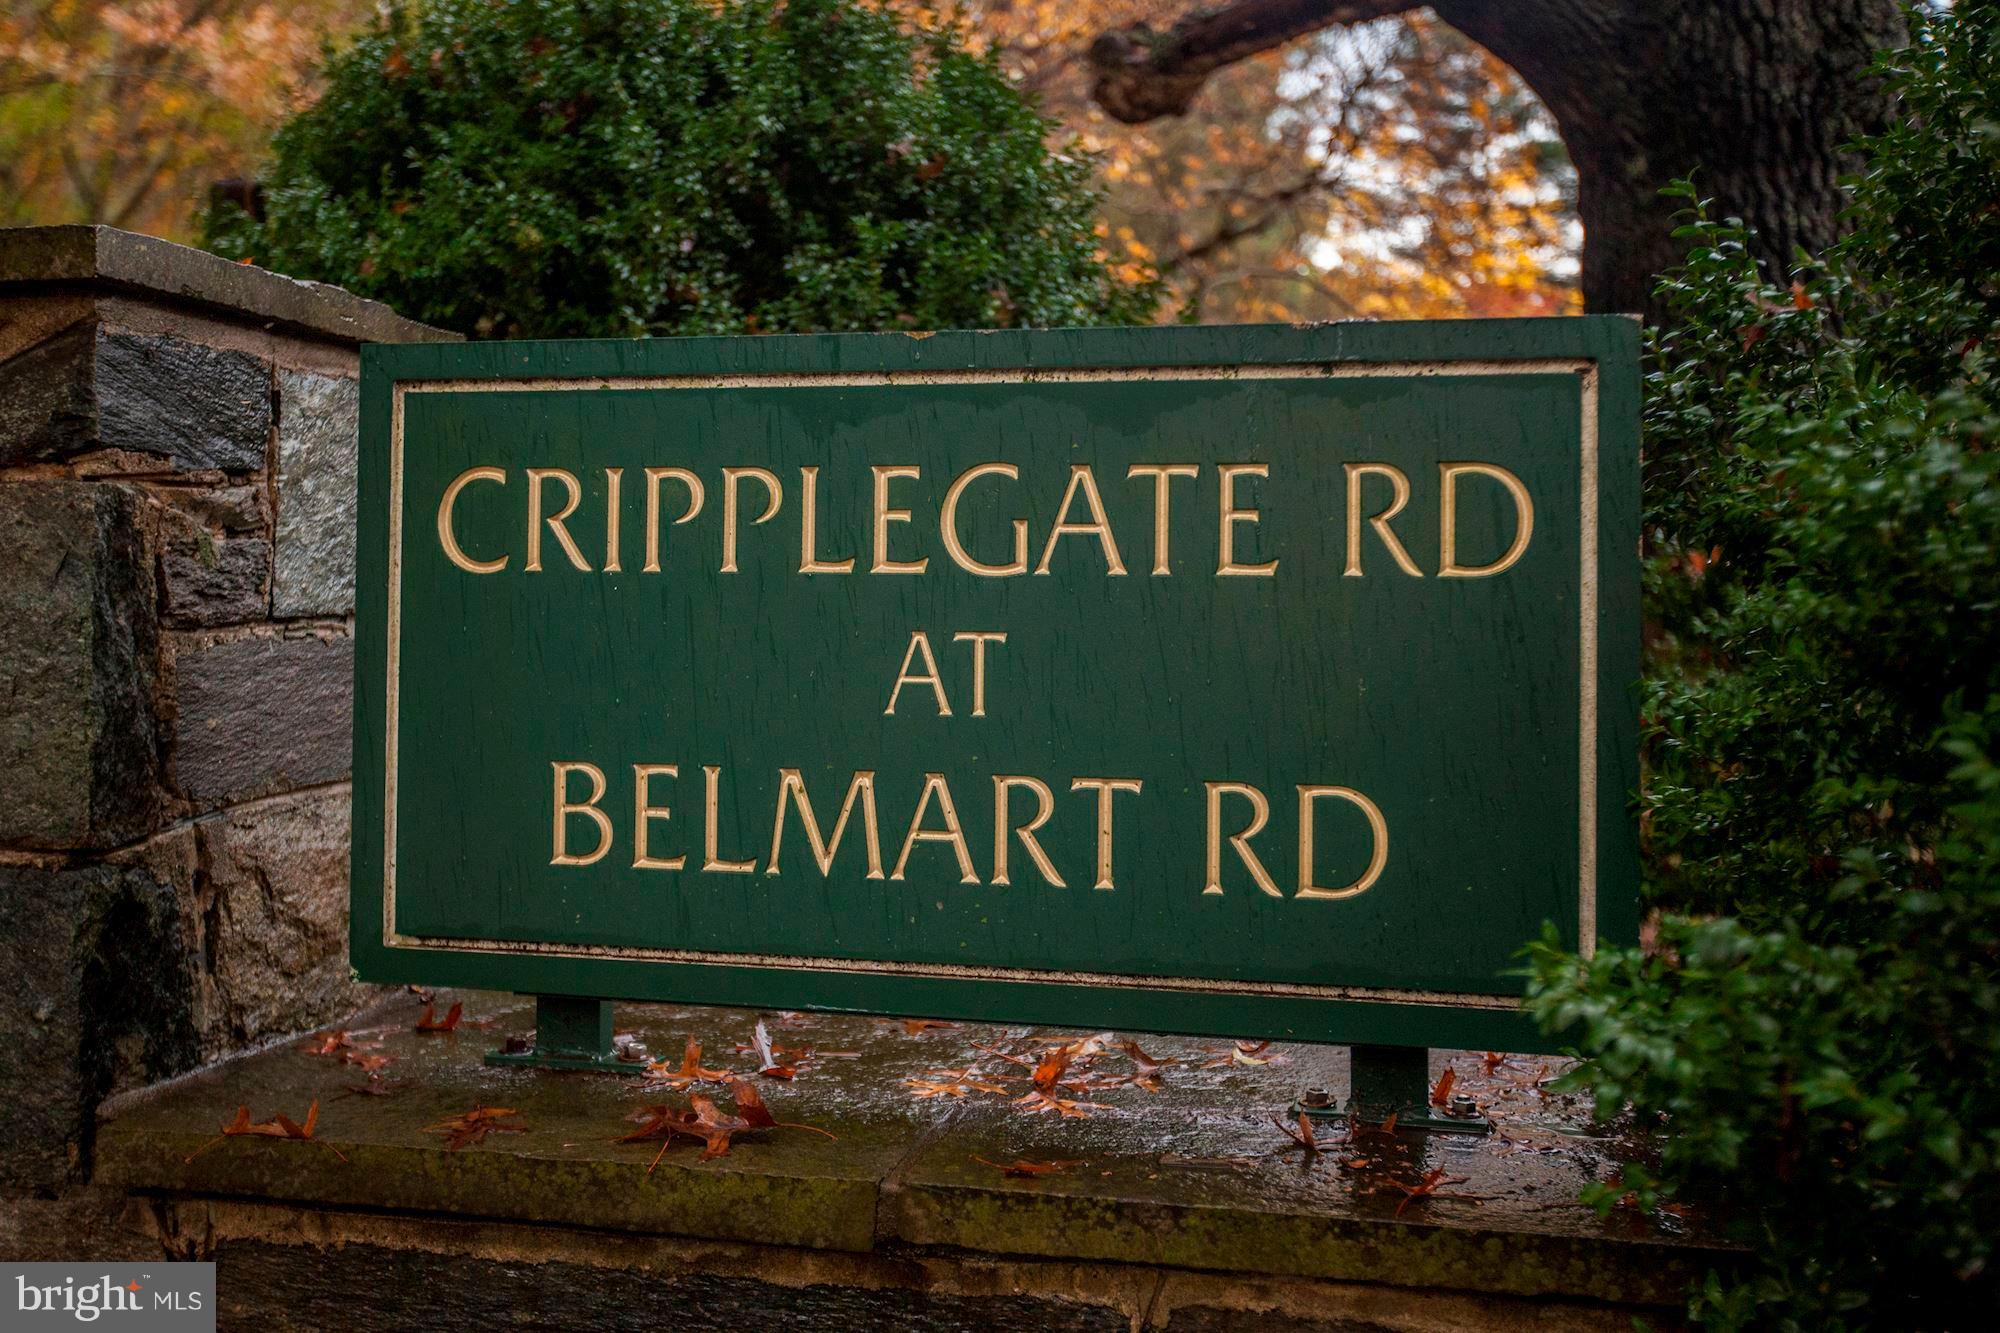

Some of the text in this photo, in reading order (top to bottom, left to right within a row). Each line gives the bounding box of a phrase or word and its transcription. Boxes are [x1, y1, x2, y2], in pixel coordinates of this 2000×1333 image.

[436, 463, 1535, 579] CRIPPLEGATE RD
[884, 630, 1009, 718] AT
[549, 761, 1389, 900] BELMART RD
